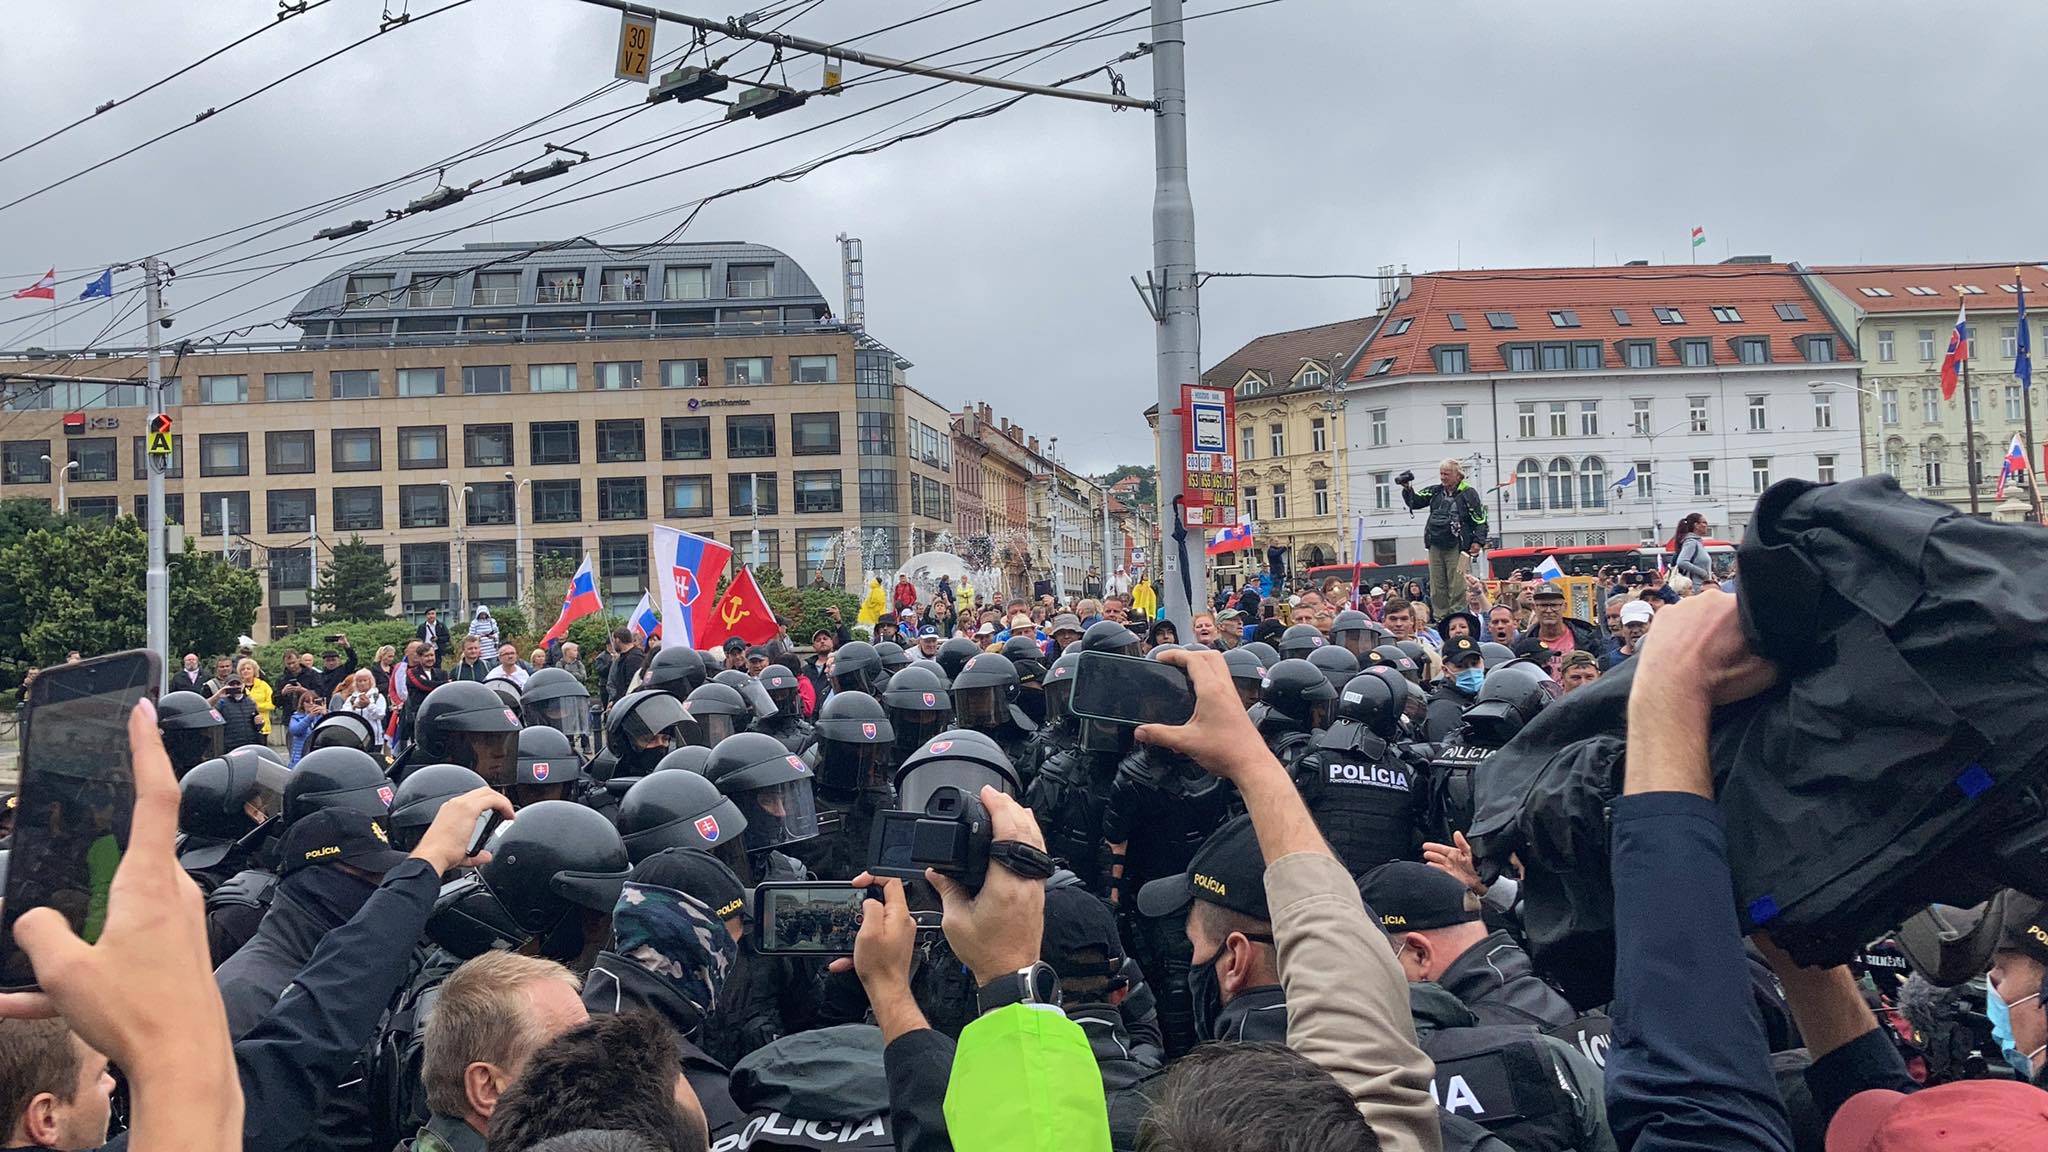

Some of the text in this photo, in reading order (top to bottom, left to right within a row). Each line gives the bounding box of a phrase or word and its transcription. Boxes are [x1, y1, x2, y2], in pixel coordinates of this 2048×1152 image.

[628, 27, 646, 50] 30
[89, 417, 119, 430] KB
[151, 433, 170, 450] A
[1329, 764, 1408, 788] POLÍCIA
[305, 846, 341, 860] POLÍCIA
[1193, 873, 1226, 896] POLÍCIA
